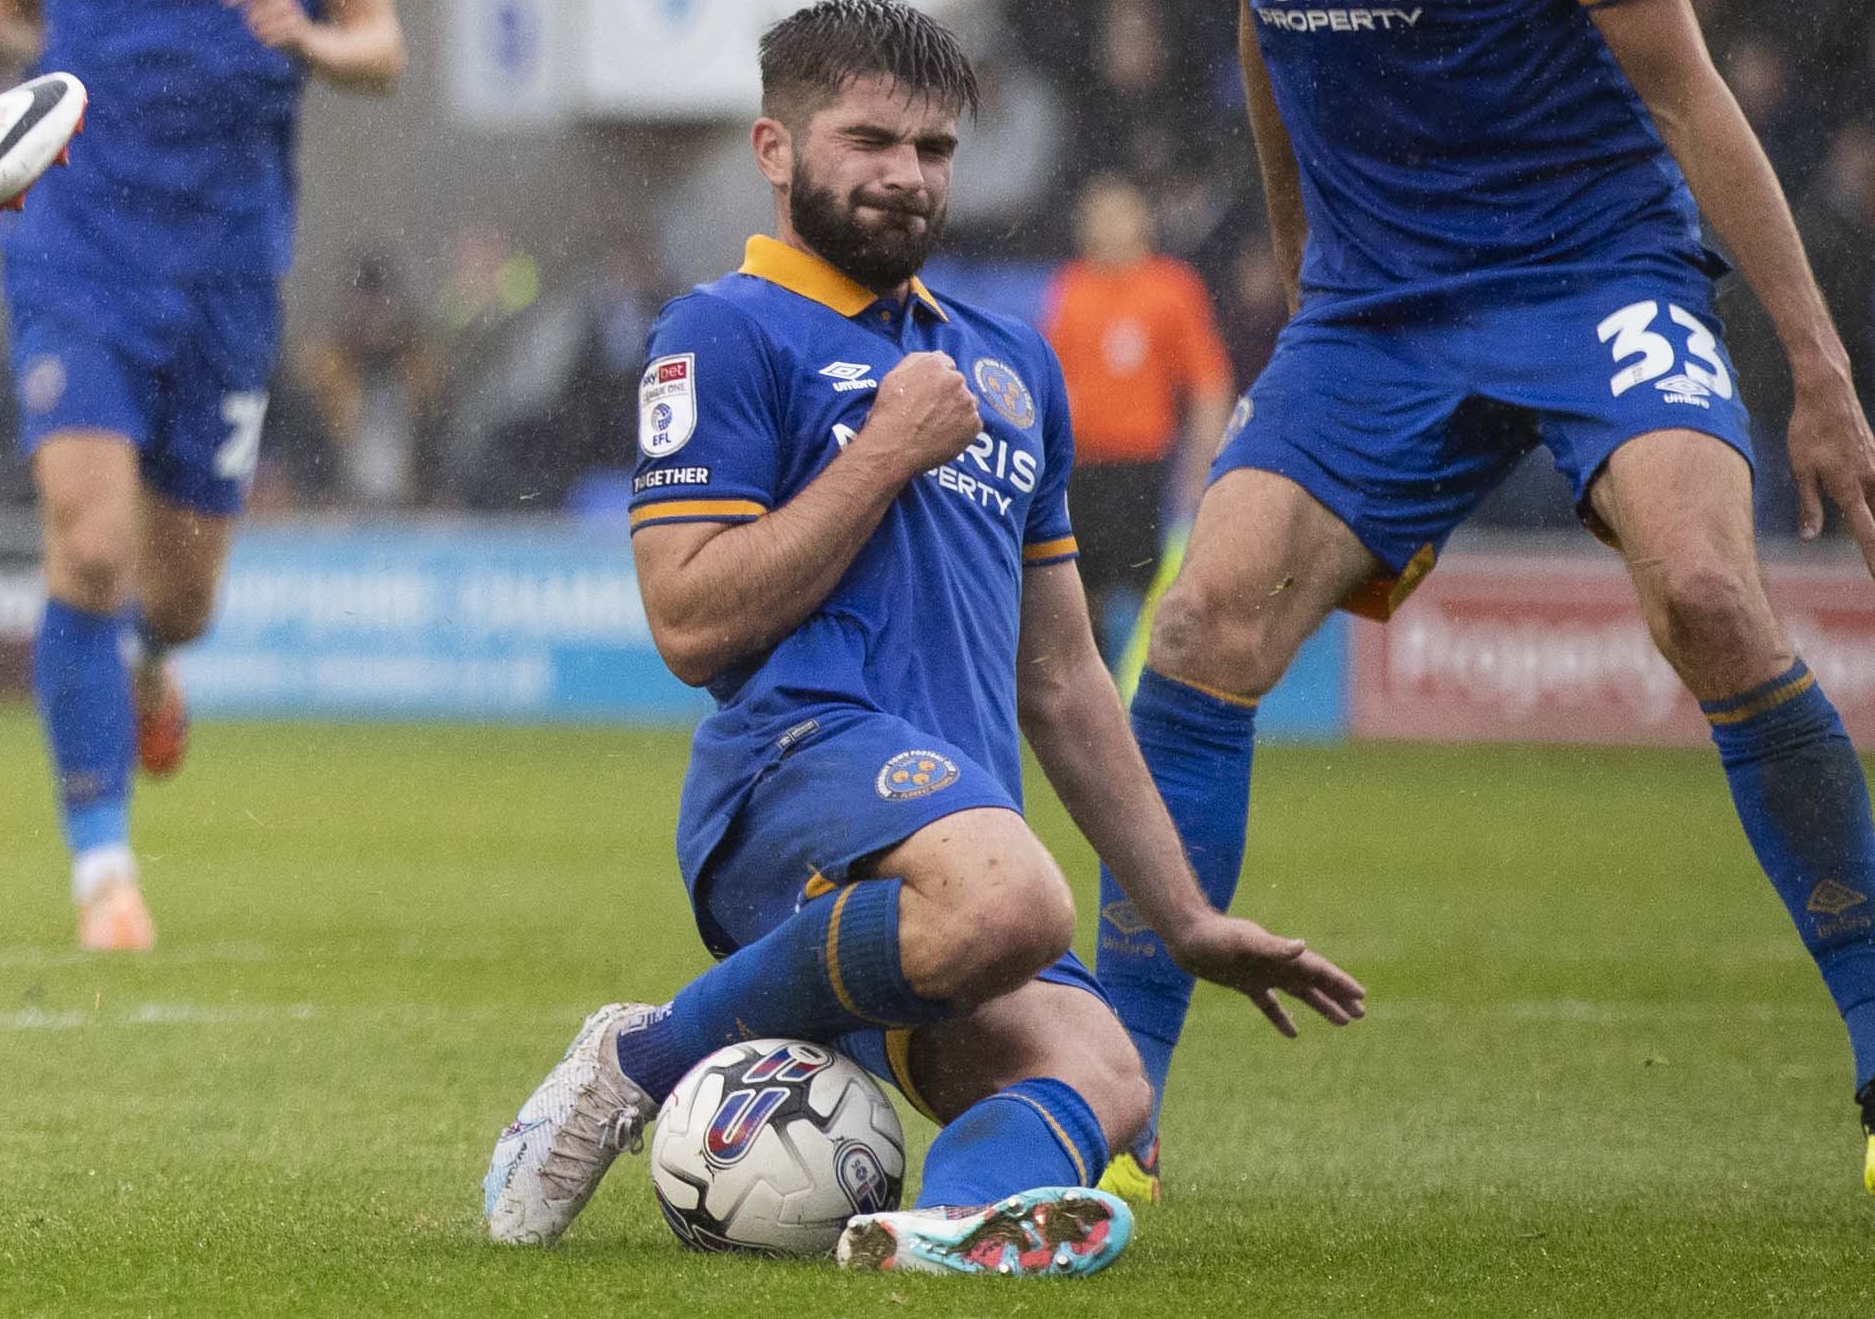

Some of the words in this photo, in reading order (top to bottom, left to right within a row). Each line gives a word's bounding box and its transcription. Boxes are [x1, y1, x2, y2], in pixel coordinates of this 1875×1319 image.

[1258, 6, 1423, 33] PROPERTY
[1596, 300, 1732, 400] 33
[832, 378, 877, 392] umbro
[652, 432, 671, 446] EFL
